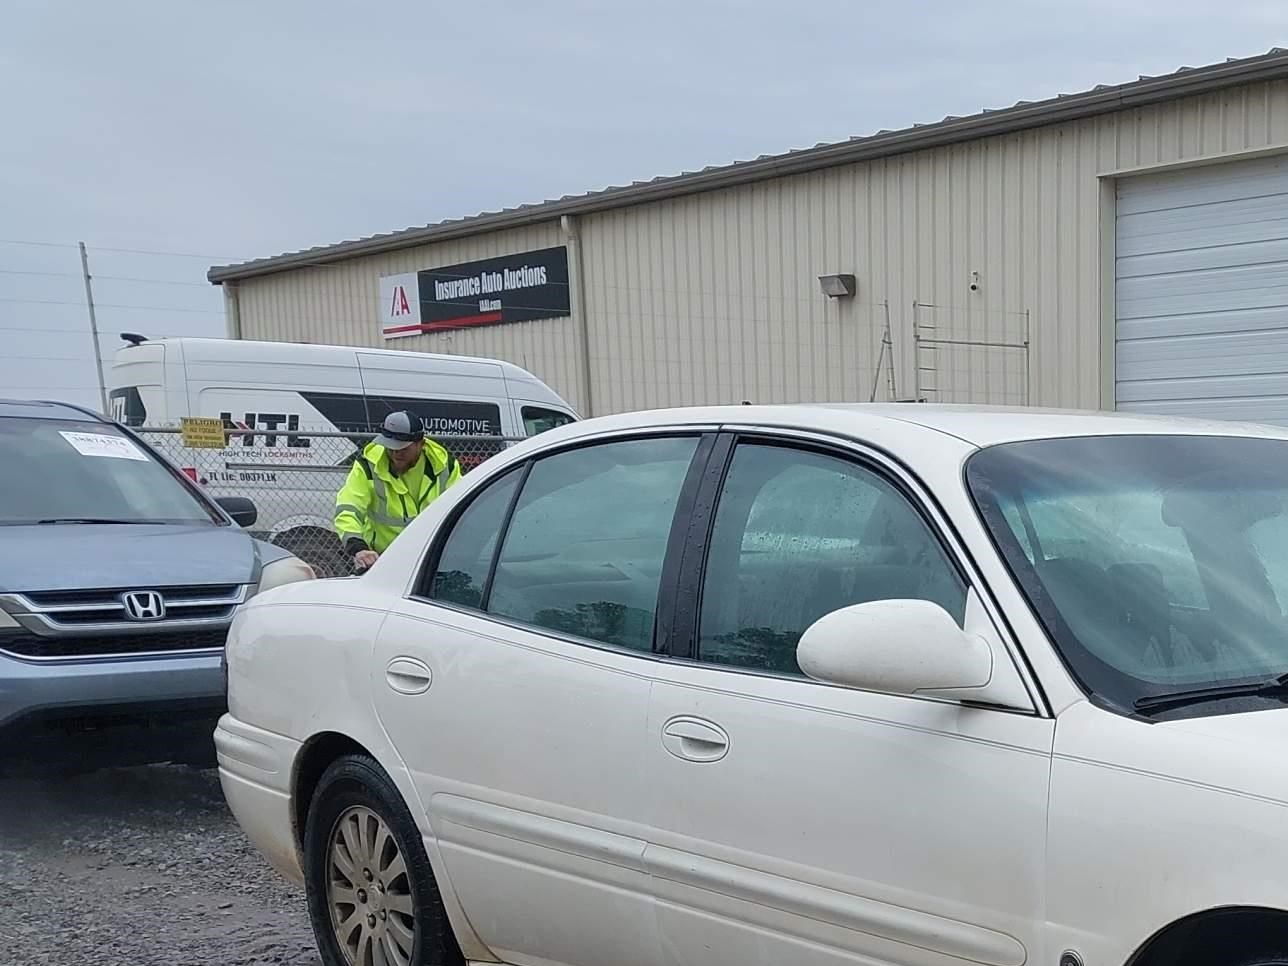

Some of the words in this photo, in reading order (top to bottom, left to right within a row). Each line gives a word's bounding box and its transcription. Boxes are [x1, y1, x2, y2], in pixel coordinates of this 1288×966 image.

[435, 279, 481, 301] Insurance
[481, 271, 503, 294] Auto
[504, 265, 547, 291] Auctions
[220, 412, 311, 448] HTL
[264, 451, 313, 459] LOCKSMITHS
